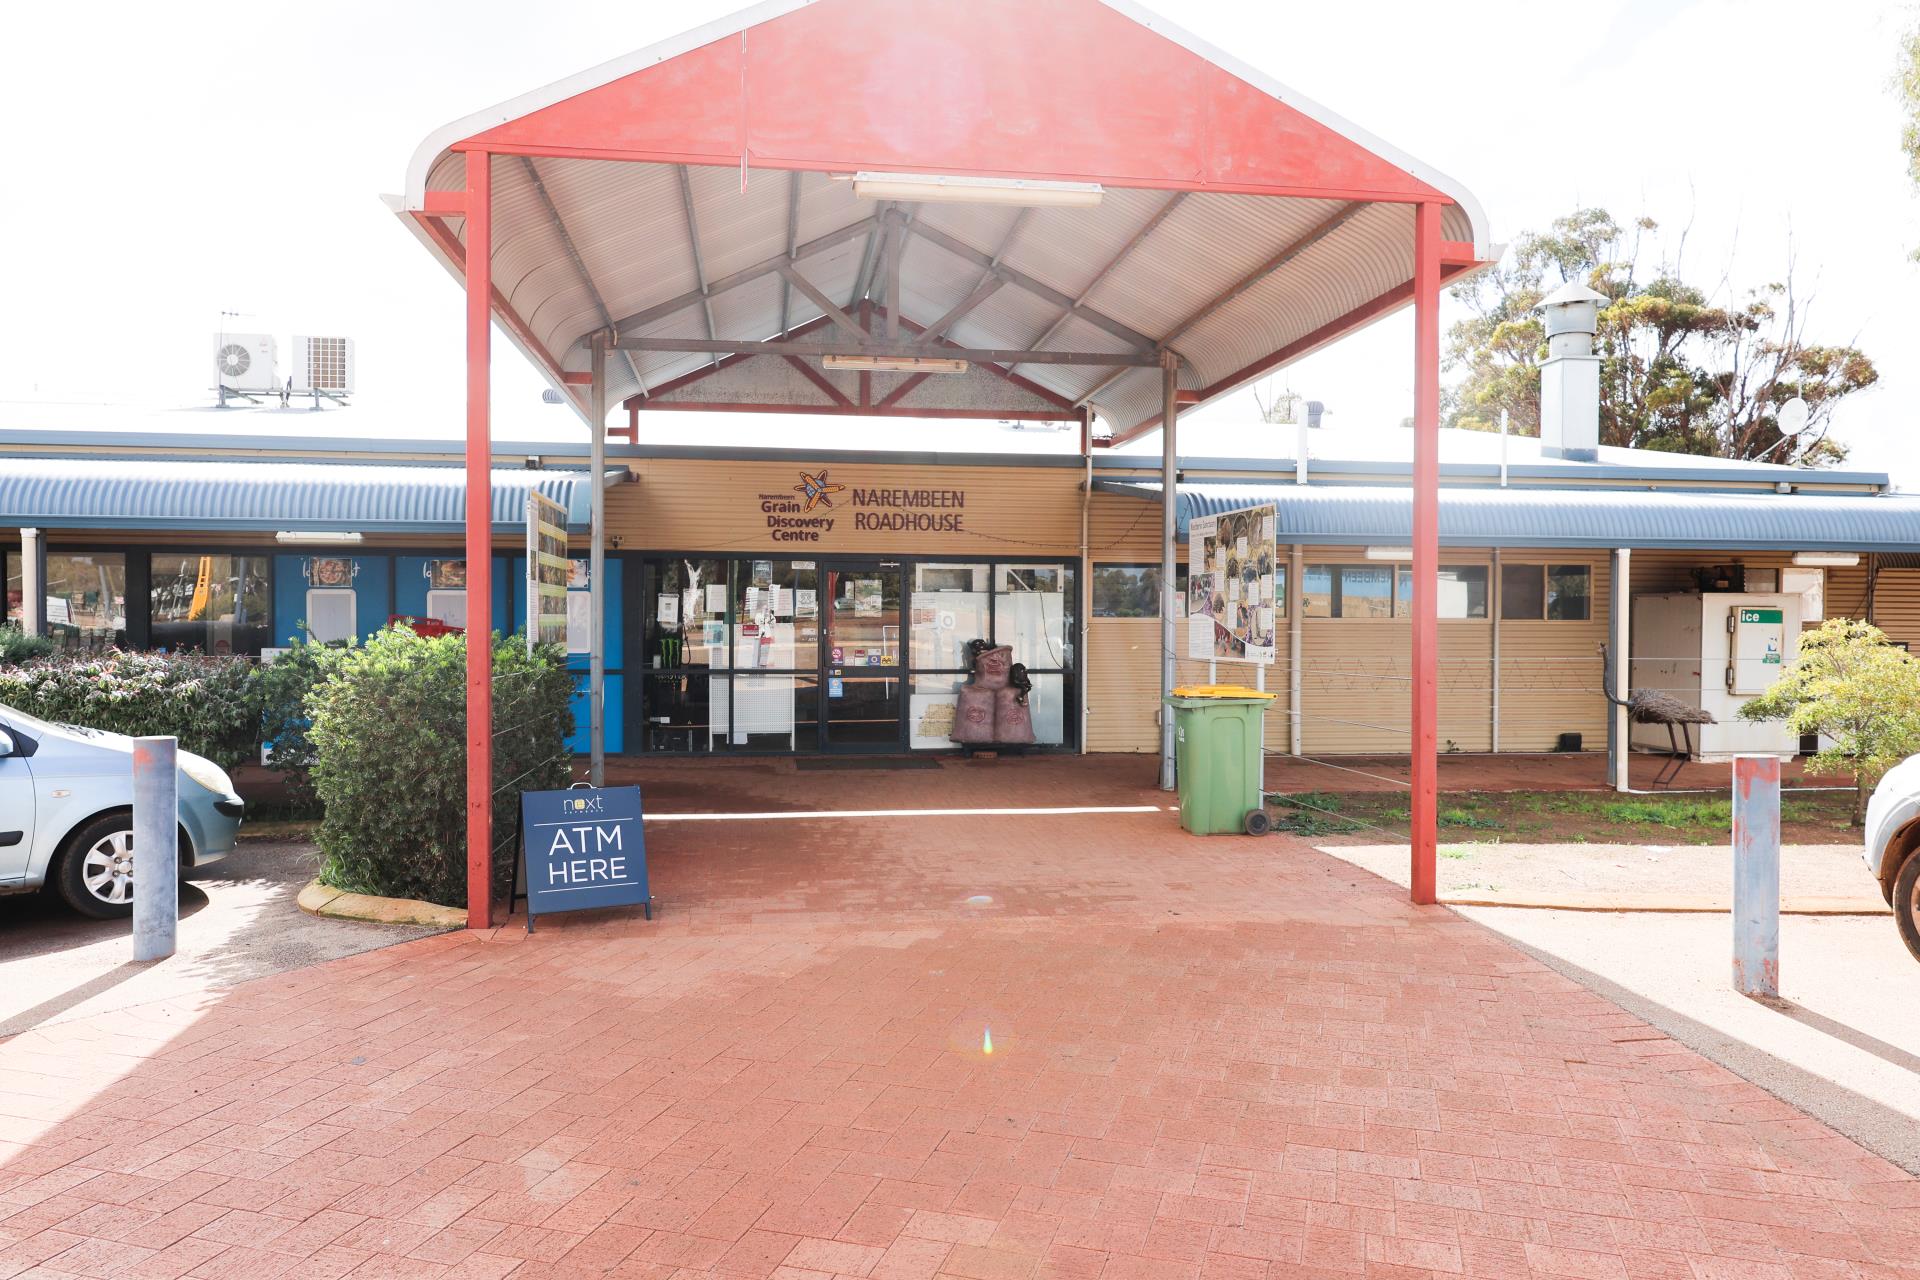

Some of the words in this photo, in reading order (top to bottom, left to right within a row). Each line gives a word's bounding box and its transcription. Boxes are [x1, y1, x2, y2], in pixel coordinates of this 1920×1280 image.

[761, 500, 800, 513] Grain
[852, 489, 965, 508] NAREMBEEN
[767, 515, 834, 531] Discovery
[855, 512, 964, 532] ROADHOUSE
[772, 529, 819, 541] Centre
[1742, 610, 1760, 622] ice
[549, 824, 622, 856] ATM
[549, 856, 628, 885] HERE
